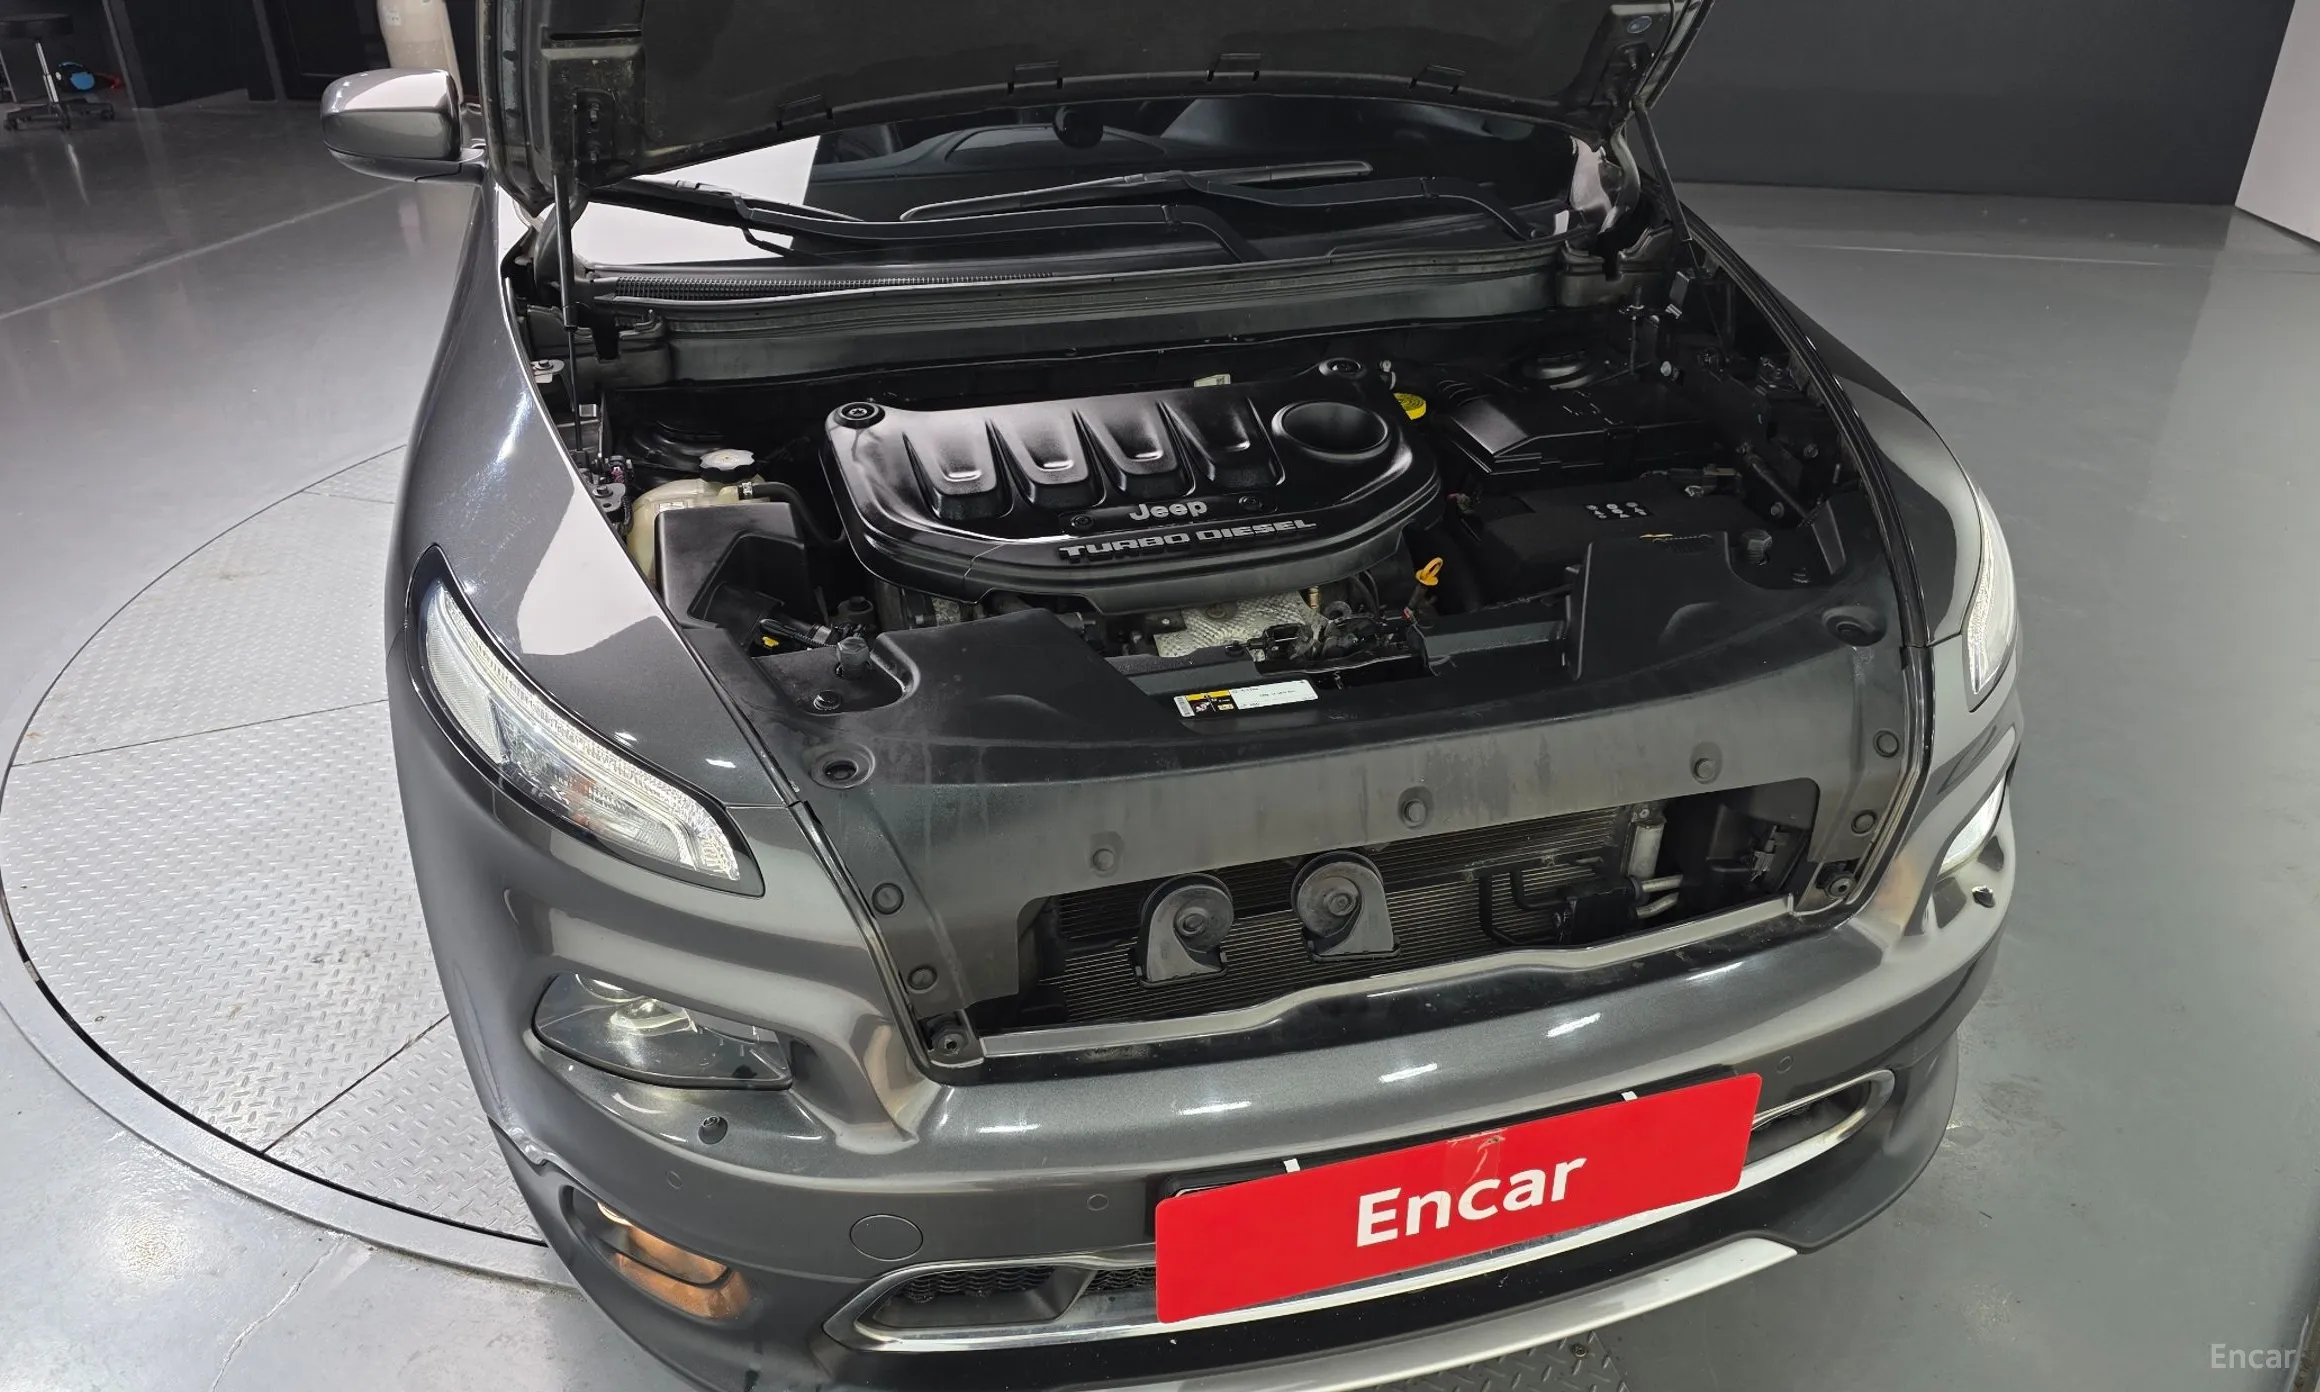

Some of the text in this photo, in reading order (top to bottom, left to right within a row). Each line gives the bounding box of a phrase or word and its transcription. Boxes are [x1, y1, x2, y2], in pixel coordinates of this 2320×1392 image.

[1129, 501, 1207, 521] Jeep
[1059, 519, 1317, 558] TURBO DIESEL
[1356, 1157, 1587, 1248] Encar
